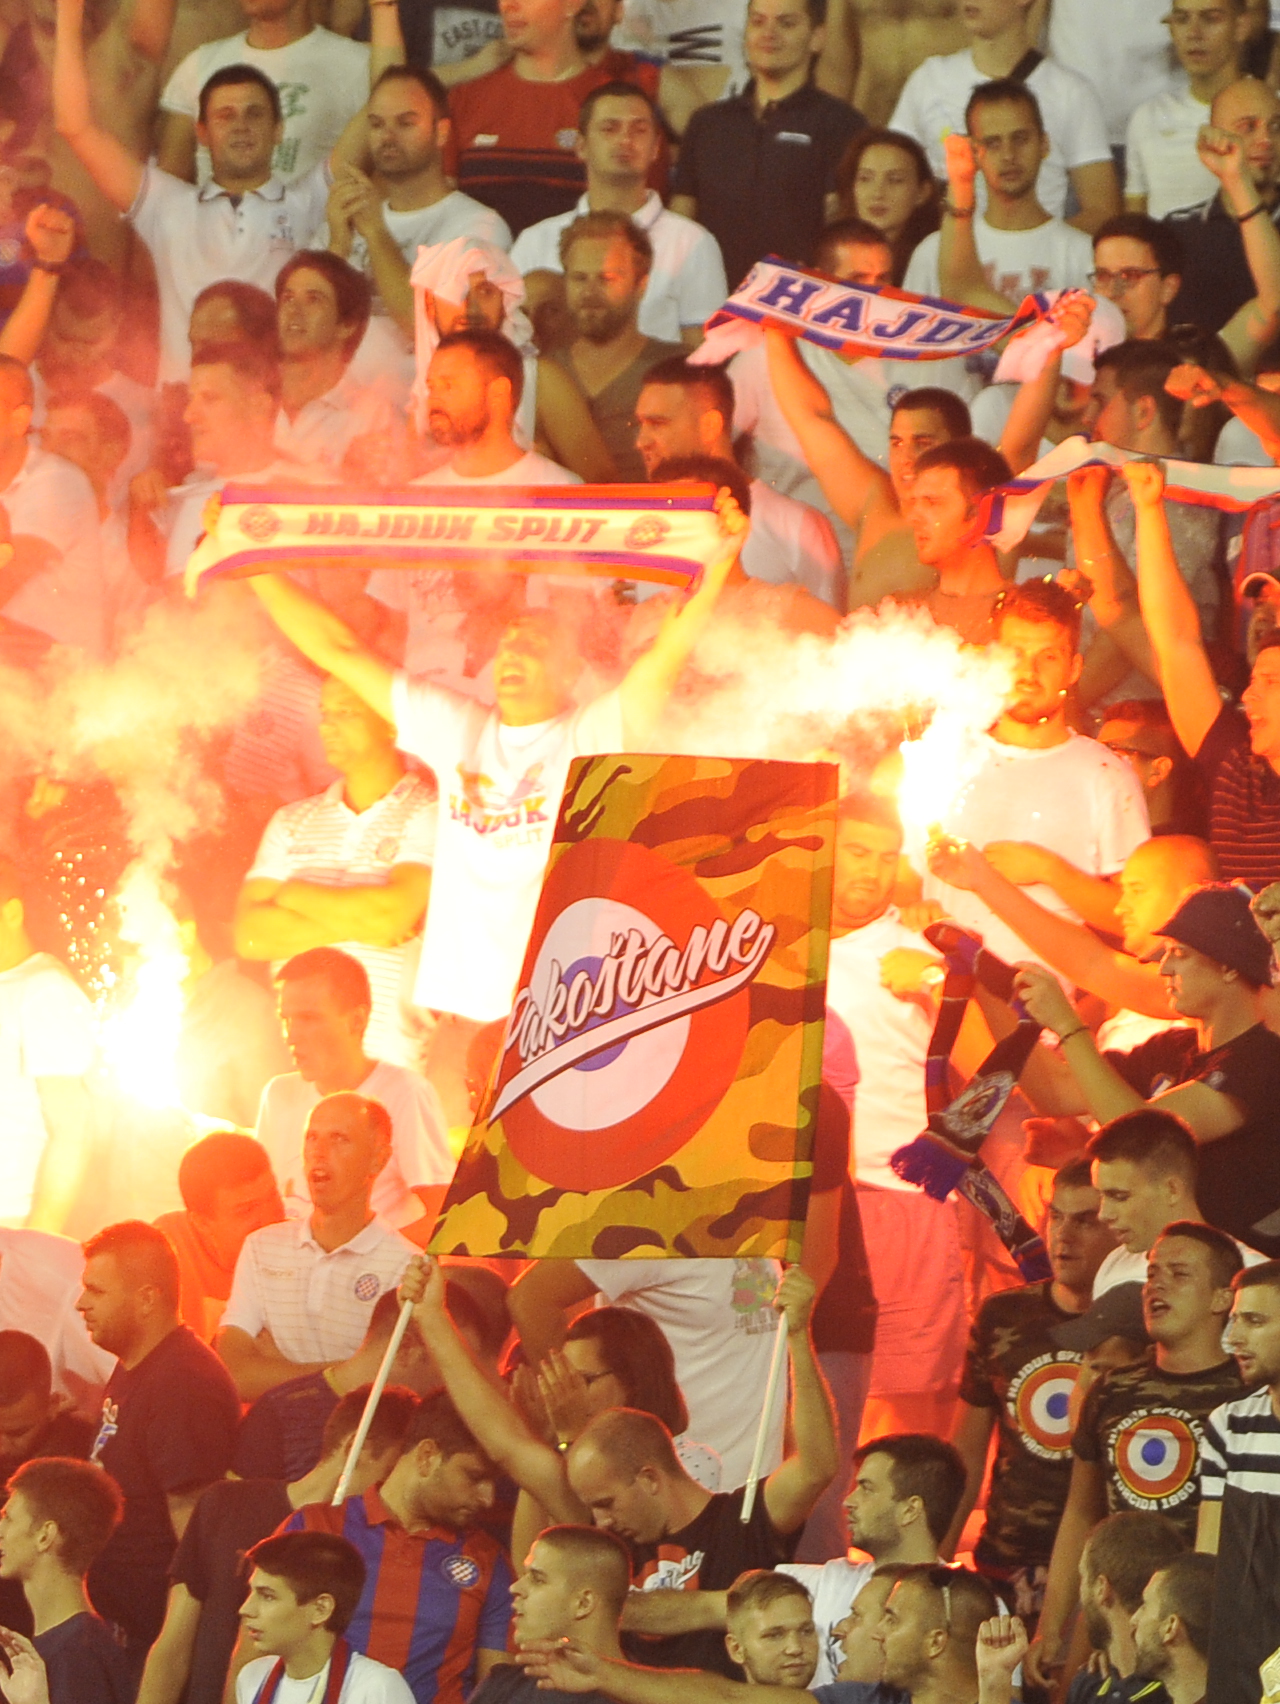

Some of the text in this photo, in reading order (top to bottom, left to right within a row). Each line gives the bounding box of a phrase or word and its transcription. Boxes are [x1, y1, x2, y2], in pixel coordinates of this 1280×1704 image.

[302, 511, 613, 544] HAJDUK SPLIT
[1006, 1352, 1054, 1399] HAJDUK
[1162, 1481, 1197, 1510] 1950
